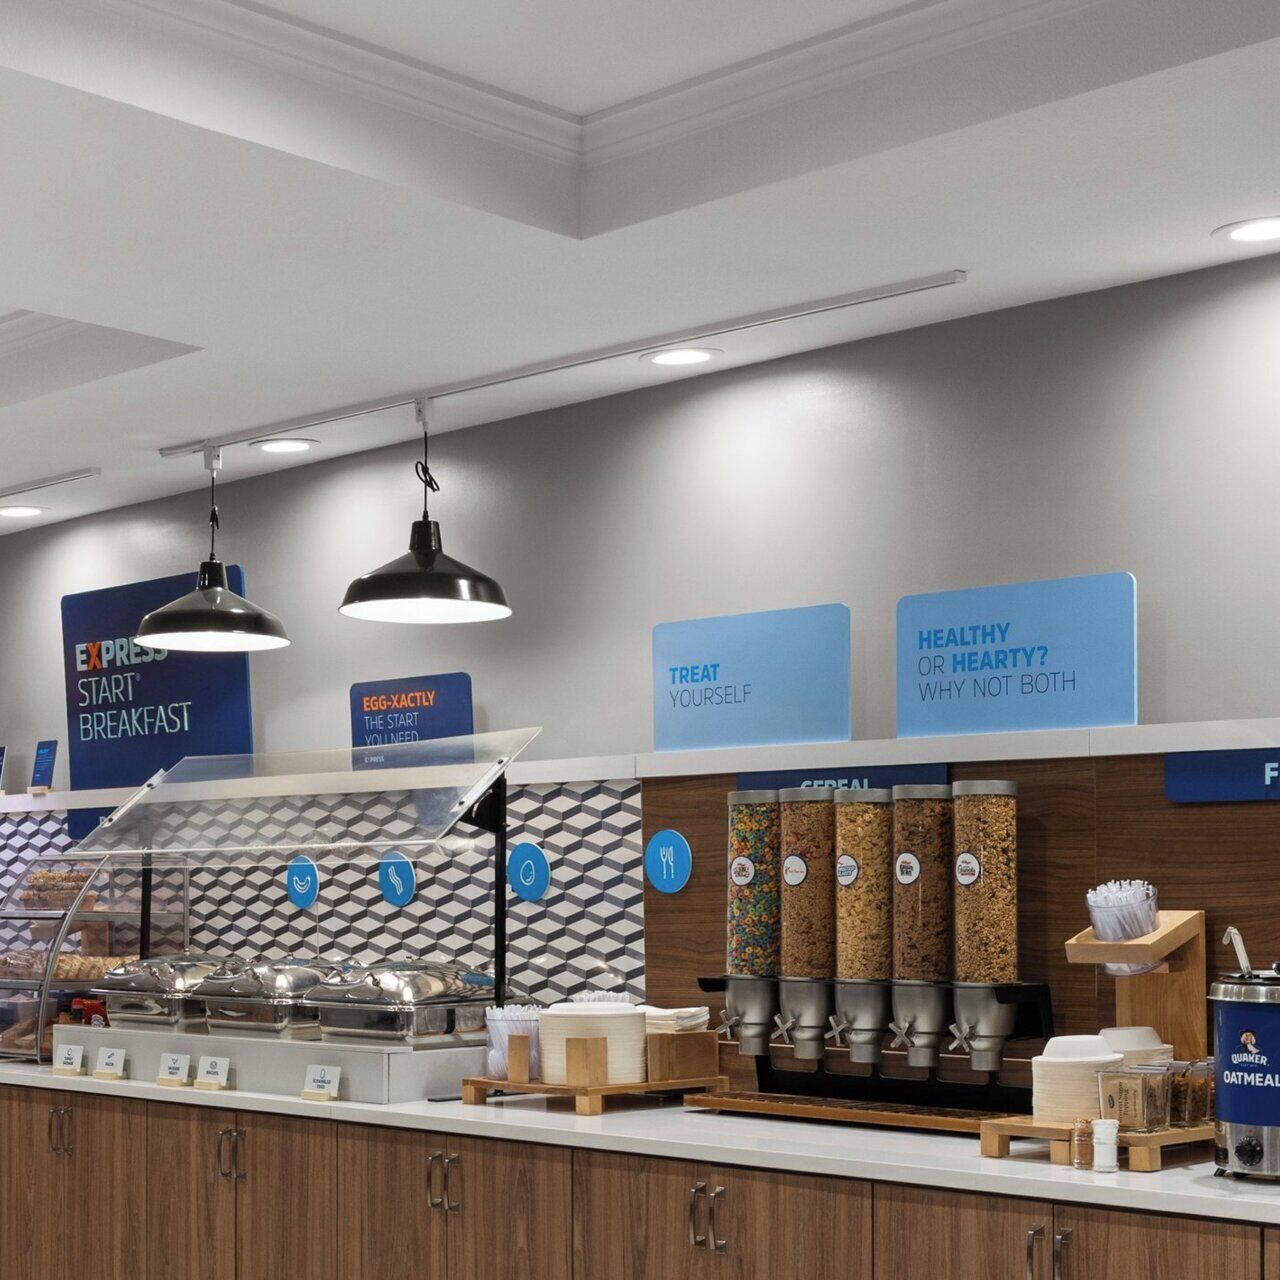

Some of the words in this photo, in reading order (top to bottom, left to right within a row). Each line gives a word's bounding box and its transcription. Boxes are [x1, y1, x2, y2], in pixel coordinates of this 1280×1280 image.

[919, 622, 1011, 650] HEALTHY
[918, 655, 945, 677] OR
[952, 646, 1049, 673] HEARTY?
[669, 663, 720, 685] TREAT
[669, 684, 752, 708] YOURSELF
[919, 679, 963, 702] WHY
[973, 675, 1013, 698] NOT
[1021, 671, 1076, 695] BOTH
[362, 690, 436, 712] EGG-XACTLY
[80, 702, 192, 741] BREAKFAST
[364, 715, 385, 730] THE
[387, 712, 419, 729] START
[1231, 1053, 1268, 1066] QUAKER
